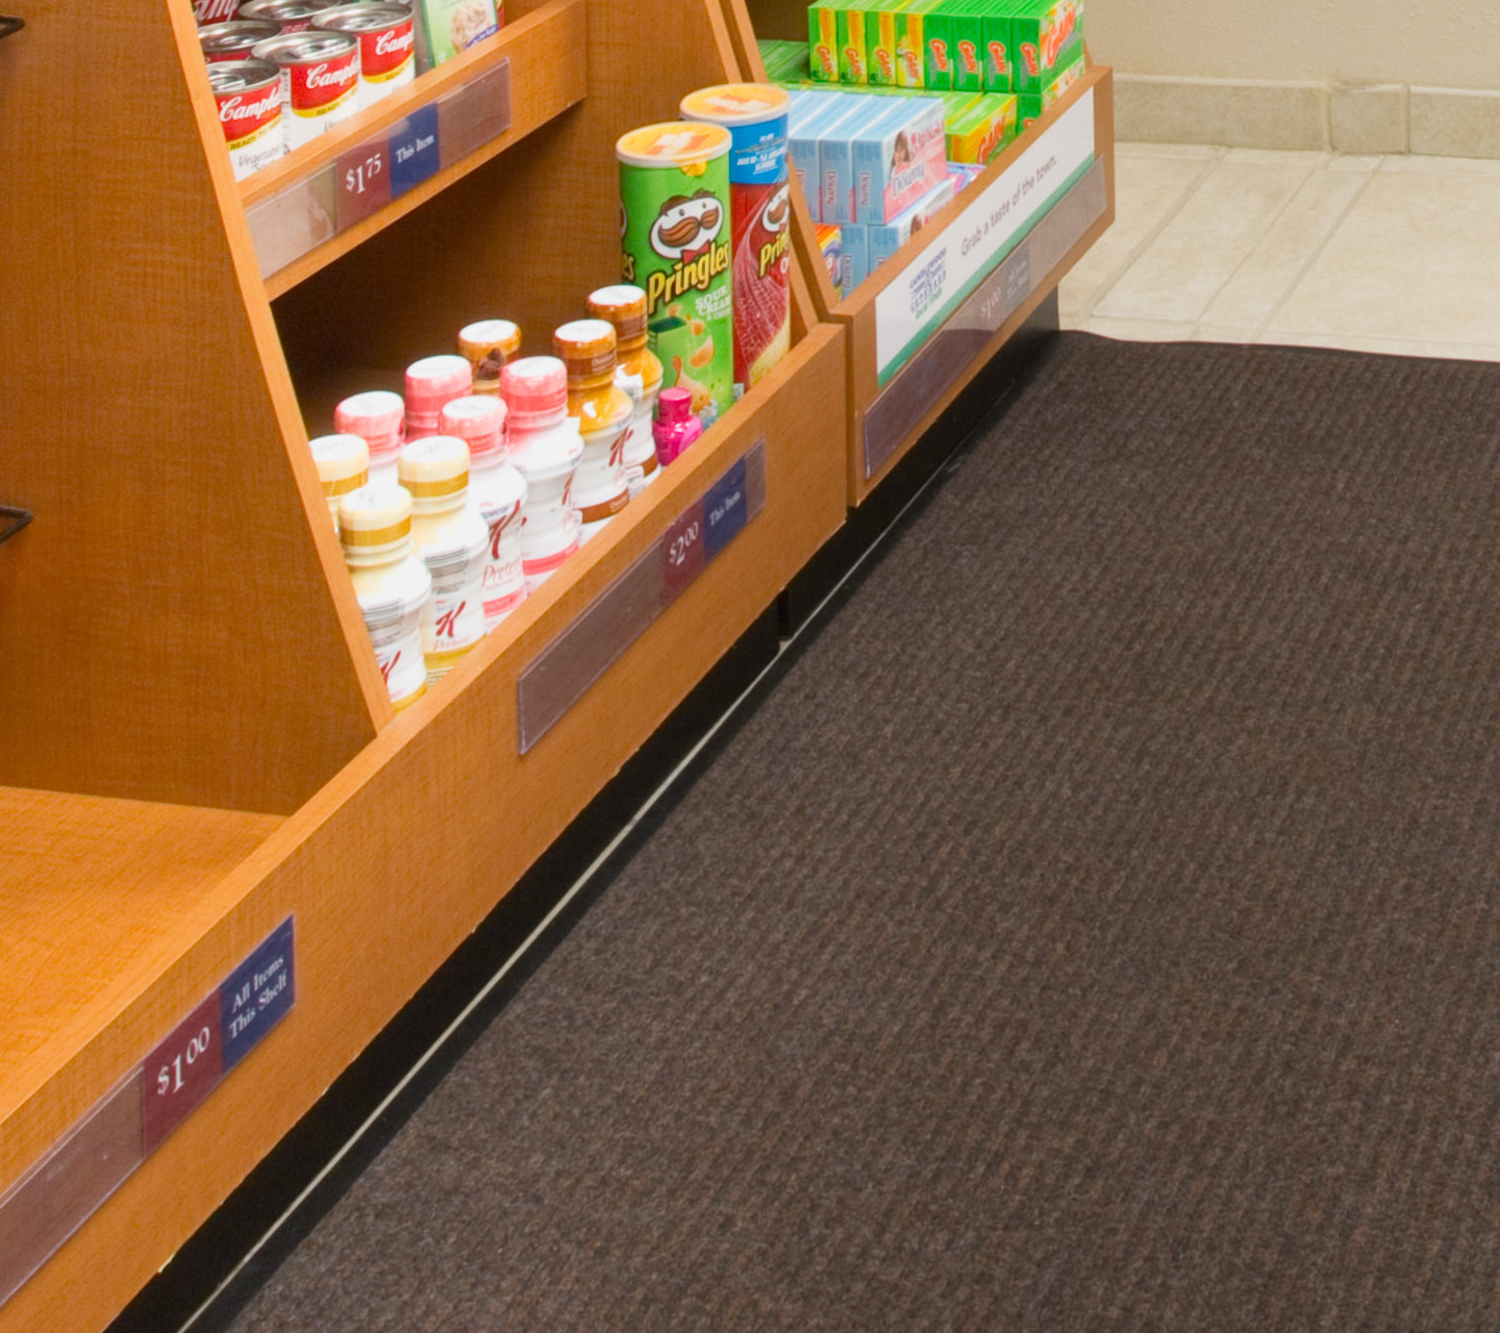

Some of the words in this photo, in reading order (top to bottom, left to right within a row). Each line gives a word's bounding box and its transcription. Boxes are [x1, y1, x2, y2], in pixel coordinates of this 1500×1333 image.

[396, 145, 414, 164] This
[416, 134, 435, 154] Item
[961, 226, 982, 256] Grab
[984, 222, 988, 234] a
[990, 200, 1010, 226] taste
[1012, 184, 1021, 206] of
[1022, 175, 1035, 195] the
[649, 241, 730, 315] Pringles
[229, 1008, 257, 1039] This
[259, 973, 287, 1010] Shelf
[232, 985, 251, 1014] All
[254, 956, 284, 992] Items
